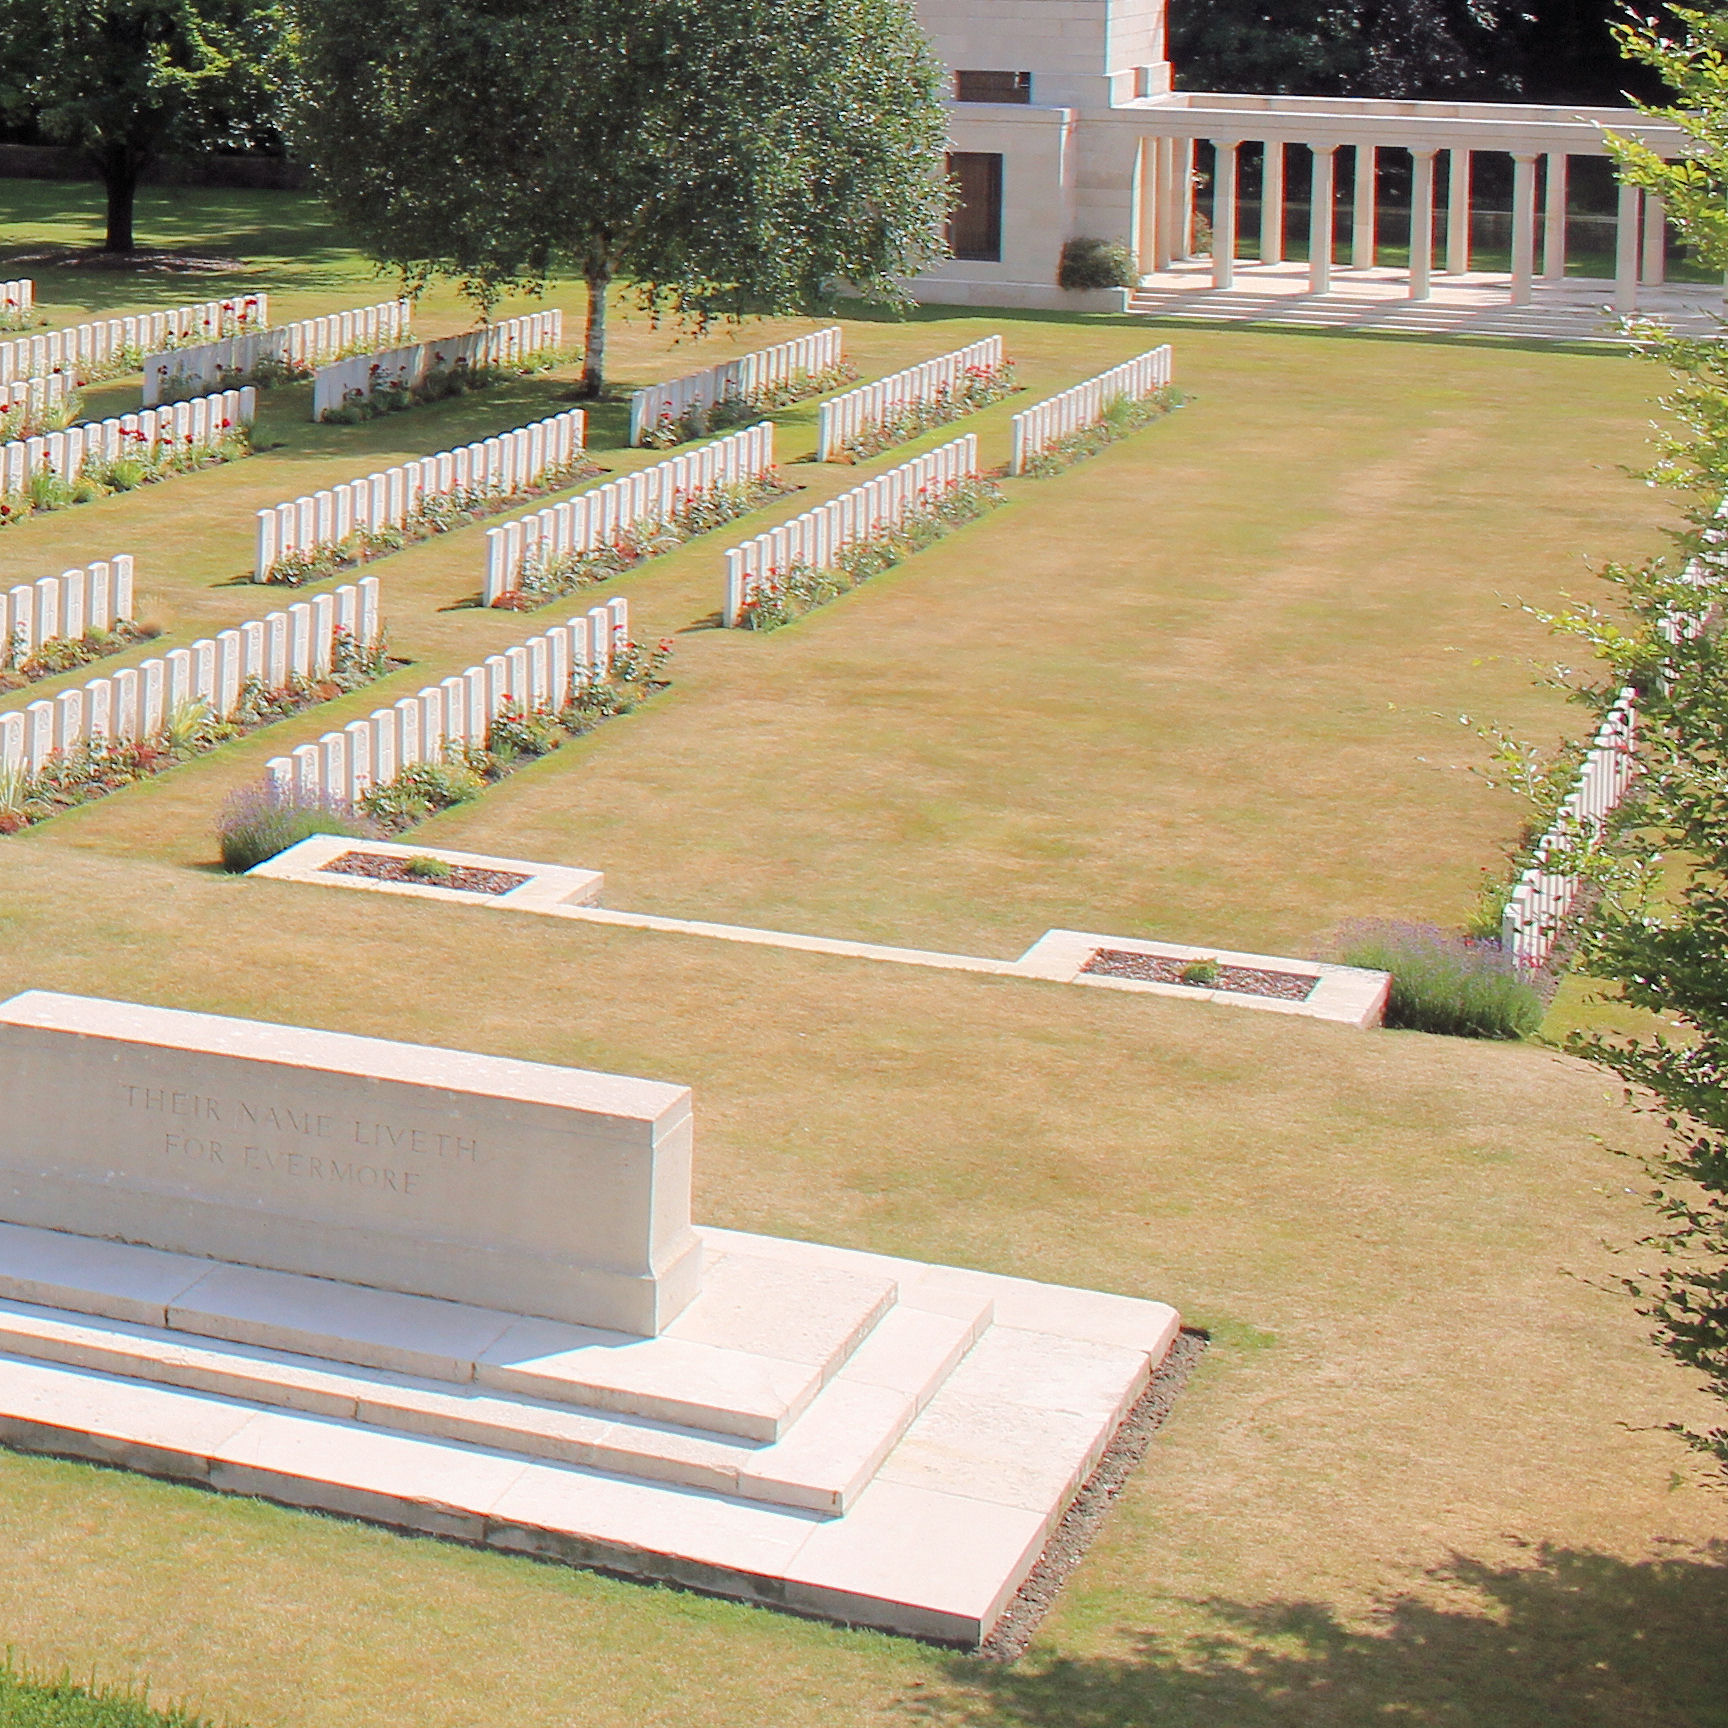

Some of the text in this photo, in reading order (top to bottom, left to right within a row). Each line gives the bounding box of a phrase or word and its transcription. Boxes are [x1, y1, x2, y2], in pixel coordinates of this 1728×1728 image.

[122, 1083, 478, 1162] THEIR NAME LIVETH
[165, 1133, 422, 1195] FOR EVERMORE
